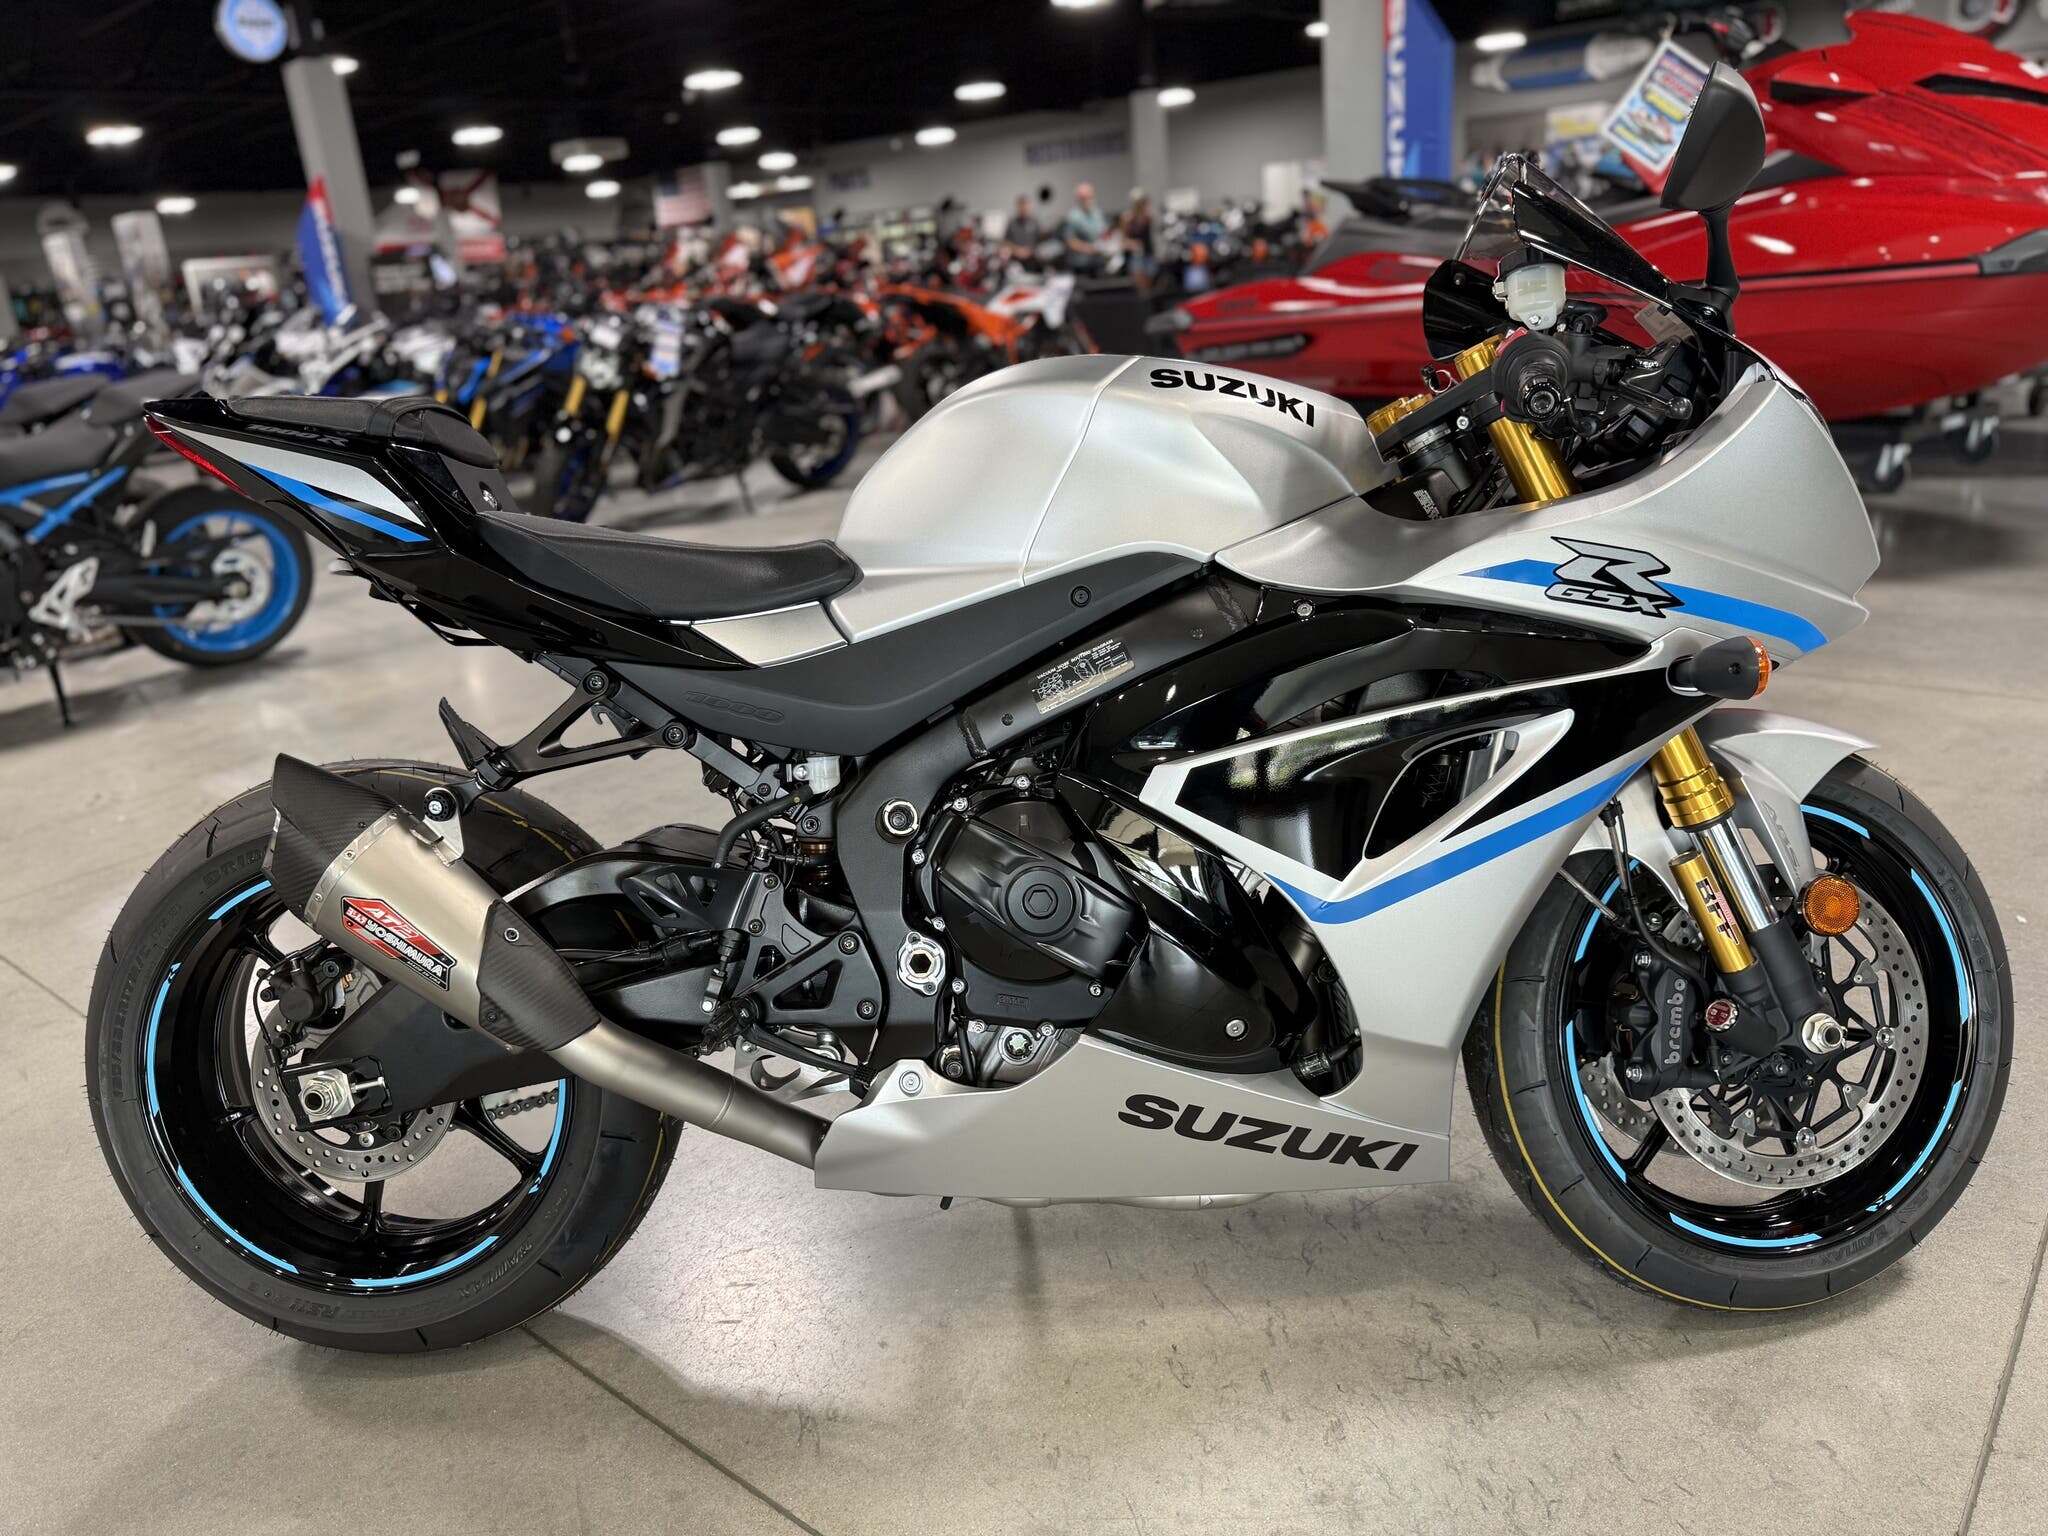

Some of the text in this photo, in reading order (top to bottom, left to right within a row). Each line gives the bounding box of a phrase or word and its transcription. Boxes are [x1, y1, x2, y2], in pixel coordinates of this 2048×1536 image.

[1387, 0, 1407, 178] SUZU
[1150, 369, 1315, 427] SUZUKI
[1545, 582, 1676, 618] GSX
[1037, 667, 1056, 679] VACUUM
[1071, 650, 1091, 662] ROUTING
[1092, 639, 1113, 652] DIAGRAM
[365, 919, 444, 977] YOSHIMURA
[1664, 978, 1686, 1064] brembo
[1118, 1093, 1420, 1172] SUZUKI
